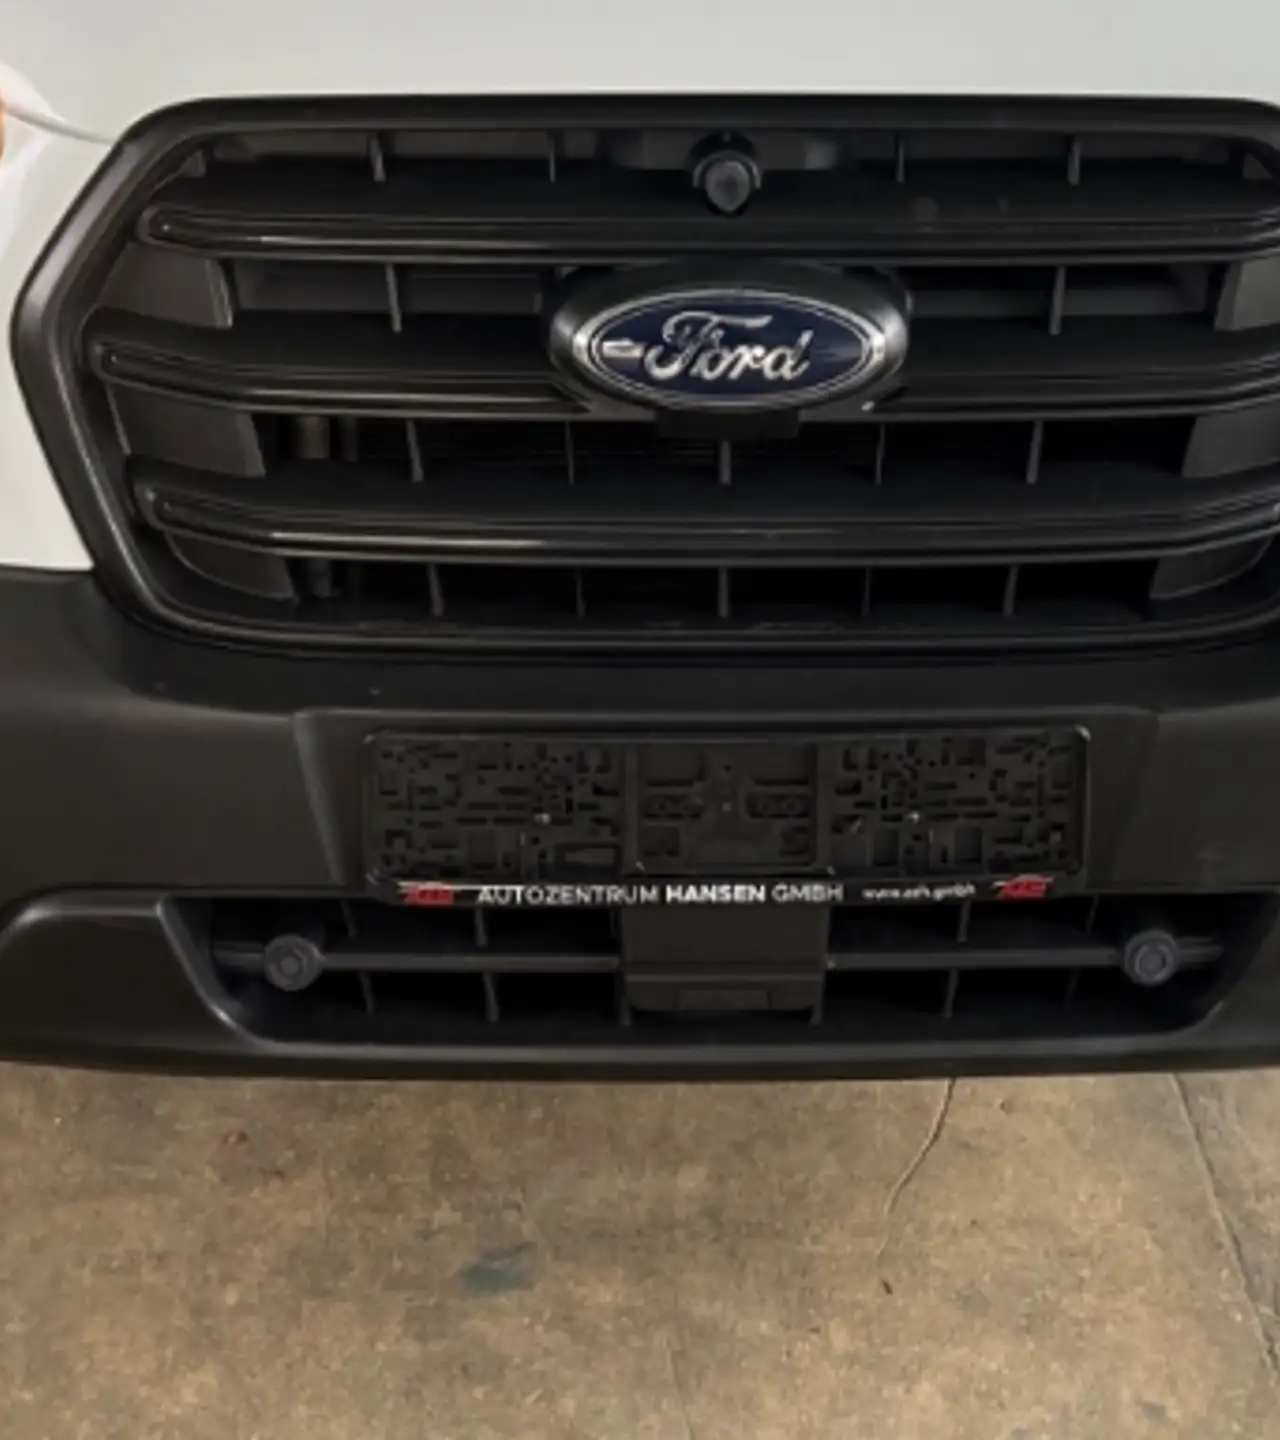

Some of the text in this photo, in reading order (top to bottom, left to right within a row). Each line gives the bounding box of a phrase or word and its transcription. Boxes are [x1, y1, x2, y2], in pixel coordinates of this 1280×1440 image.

[645, 310, 814, 380] Ford
[477, 884, 658, 905] AUTOZENTRUM
[666, 883, 766, 902] HANSEN
[770, 884, 845, 902] GMBH
